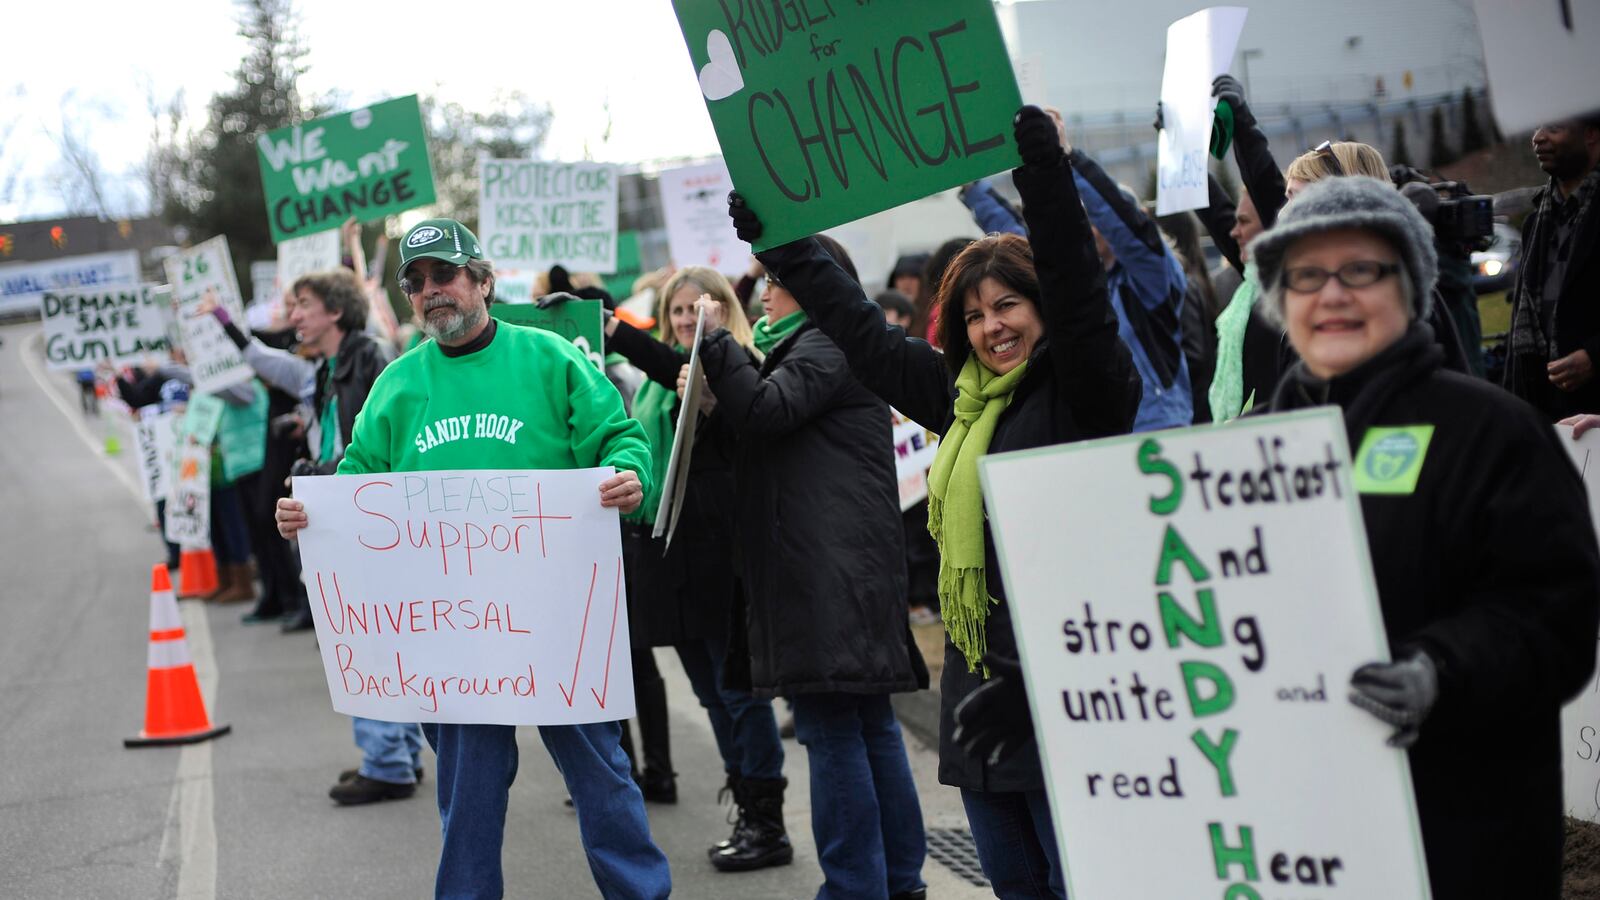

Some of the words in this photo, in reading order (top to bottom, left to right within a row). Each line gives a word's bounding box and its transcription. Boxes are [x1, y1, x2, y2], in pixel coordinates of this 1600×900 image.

[809, 33, 843, 61] for
[748, 19, 1006, 202] CHANGE
[257, 126, 328, 172] WE
[483, 163, 573, 198] PROTECT
[575, 167, 611, 192] OUR
[275, 170, 416, 235] CHANGE
[486, 232, 535, 259] GUN
[43, 288, 153, 317] DEMAND
[76, 309, 139, 332] SAFE
[415, 414, 472, 453] SANDY
[474, 413, 524, 445] HOOK
[404, 476, 529, 512] PLEASE
[354, 480, 572, 576] Support
[1155, 523, 1269, 586] And
[316, 571, 532, 635] UNIVERSAL
[1276, 674, 1328, 702] and
[1207, 822, 1345, 887] Hear
